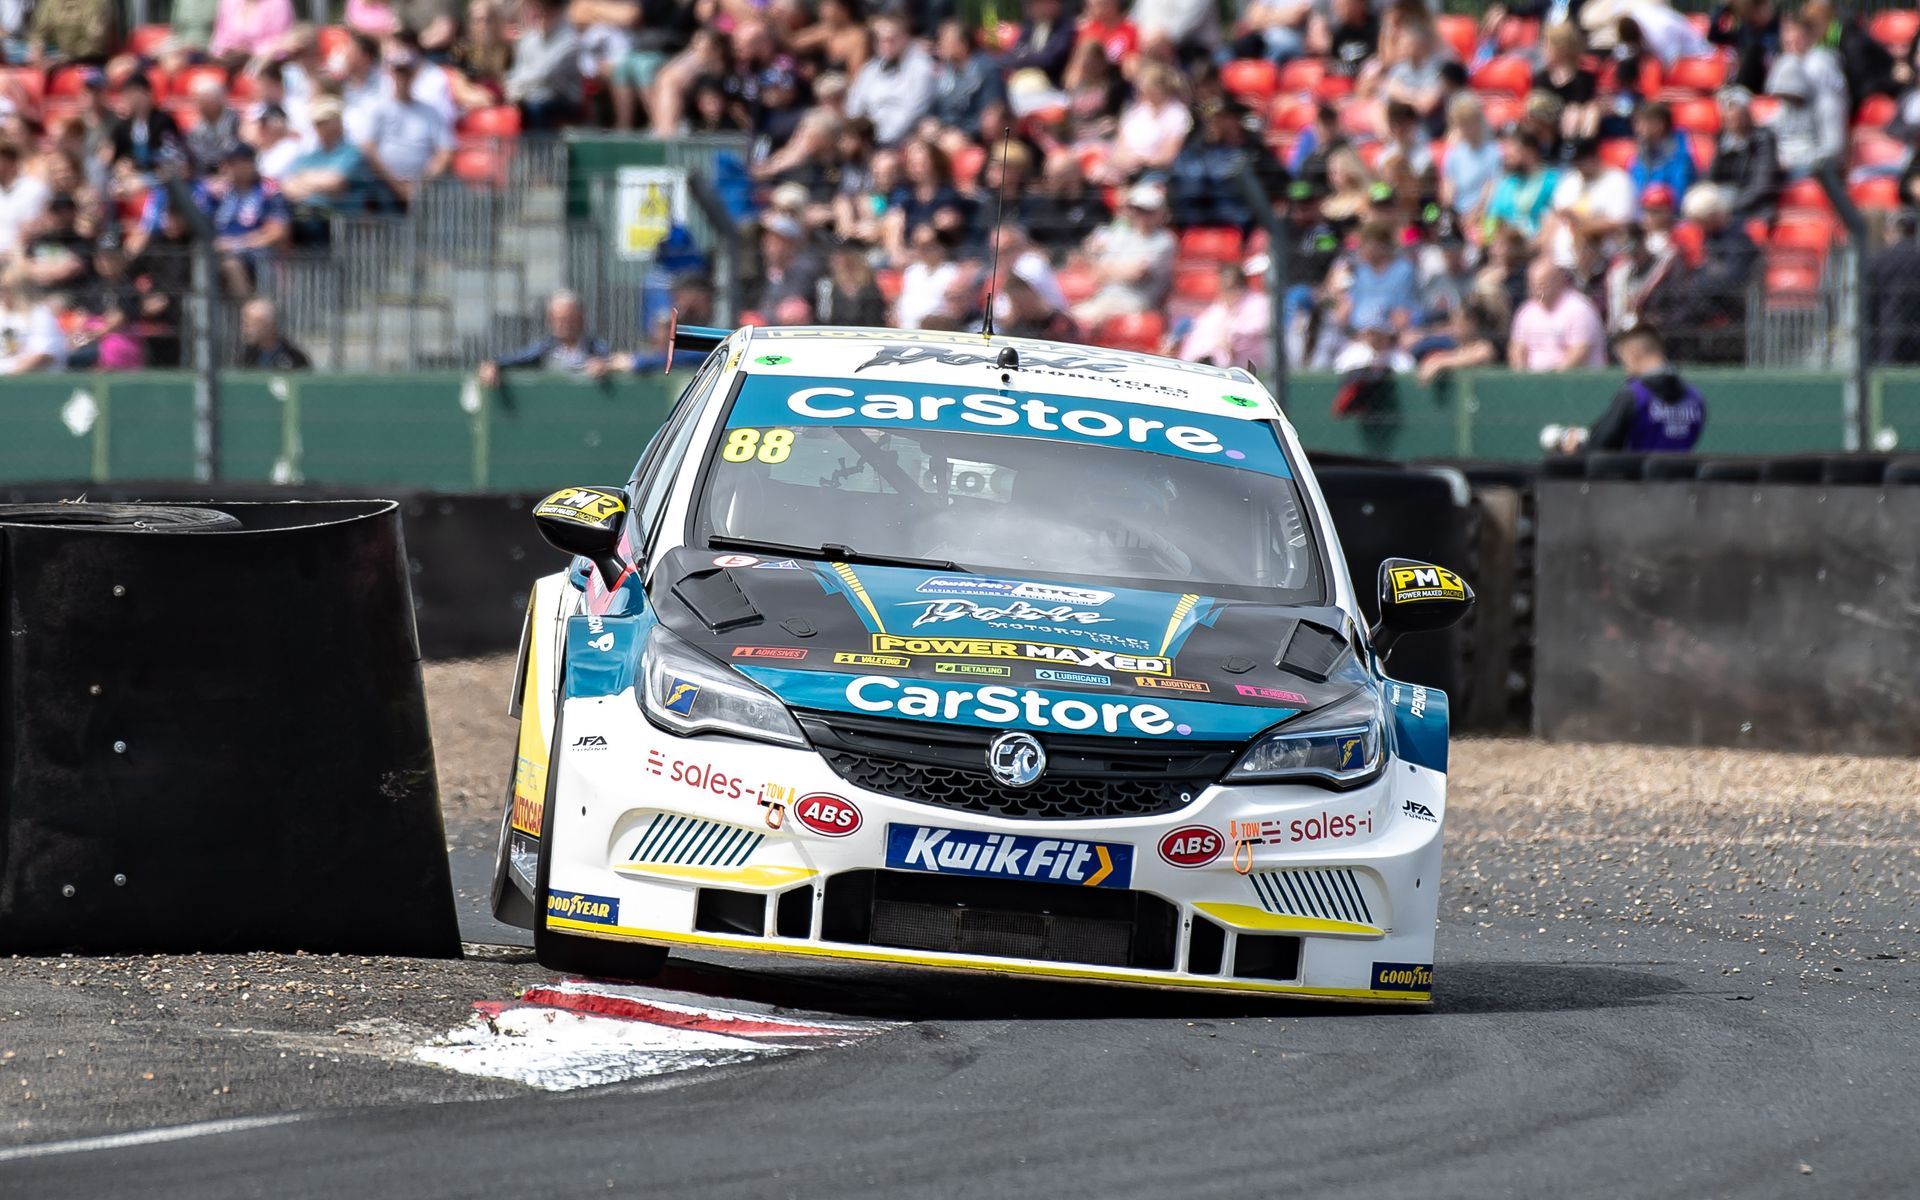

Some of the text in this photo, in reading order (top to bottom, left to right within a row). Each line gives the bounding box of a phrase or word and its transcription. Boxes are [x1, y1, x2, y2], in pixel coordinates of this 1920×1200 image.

[722, 427, 795, 464] 88
[545, 488, 619, 515] PMR
[1394, 568, 1461, 590] PMR
[1398, 589, 1462, 601] POWER MAXED RACING
[988, 621, 1150, 647] MOTORCYCLES
[755, 649, 801, 658] ADHESIVES
[861, 655, 901, 665] VALETING
[879, 636, 1165, 672] POWER MAXED
[961, 665, 1003, 674] DETAILING
[1056, 672, 1107, 684] LUBRICANTS
[1160, 680, 1203, 690] ADDITIVES
[572, 735, 607, 746] JFA
[670, 760, 765, 806] sales-i
[766, 781, 785, 800] TOW
[803, 801, 854, 827] ABS
[1402, 800, 1436, 818] JFA
[1403, 811, 1438, 824] TUNING
[1241, 822, 1260, 838] TOW
[1290, 810, 1373, 842] sales-i
[1169, 836, 1216, 857] ABS
